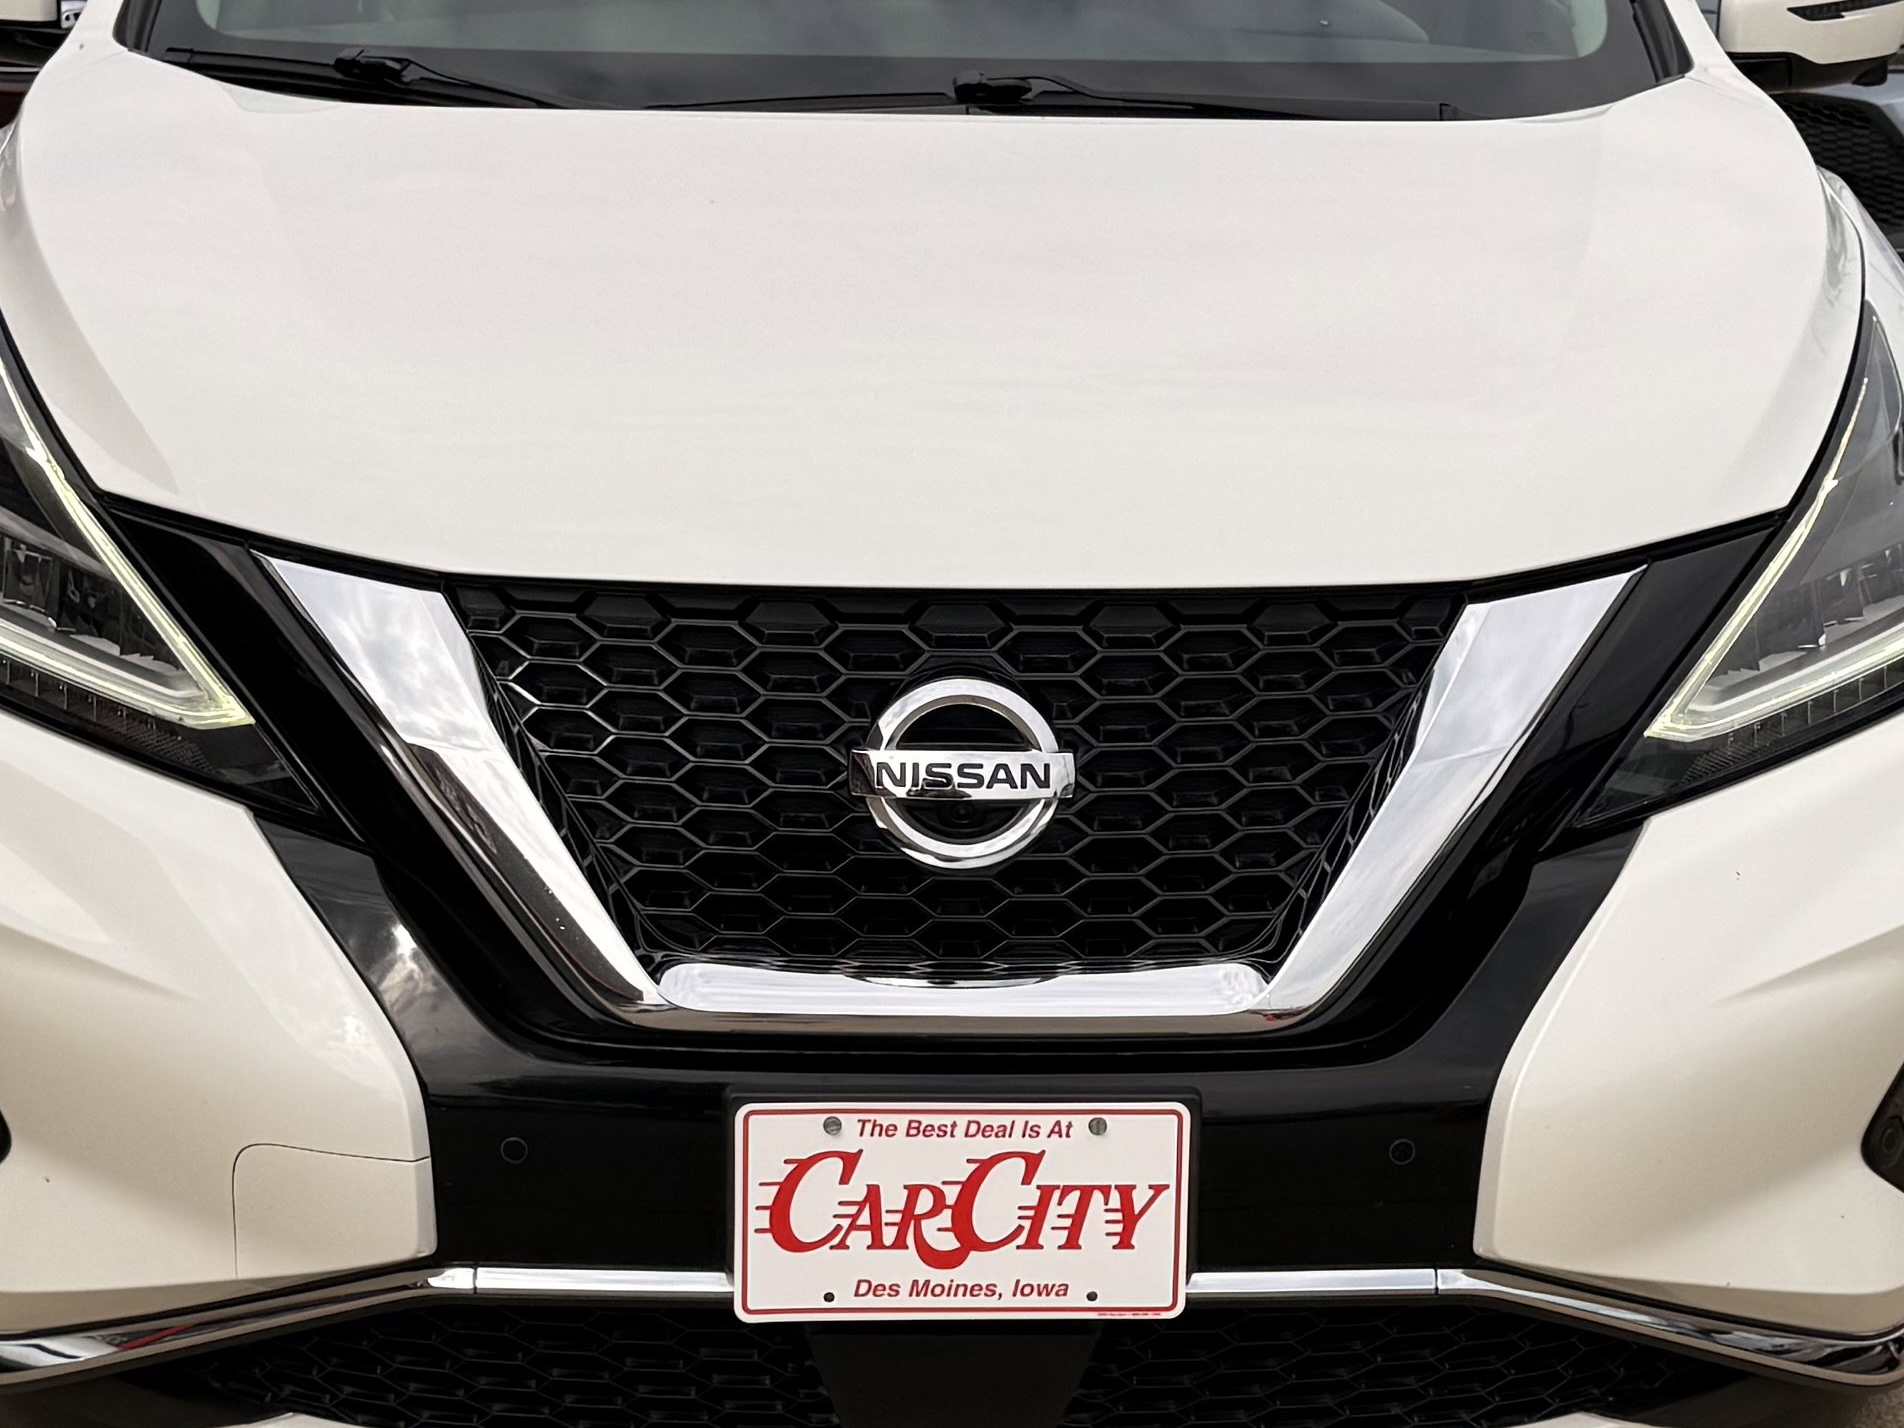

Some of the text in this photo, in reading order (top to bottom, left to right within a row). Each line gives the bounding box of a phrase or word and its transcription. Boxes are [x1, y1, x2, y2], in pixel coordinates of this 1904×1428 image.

[876, 761, 1051, 790] NISSAN
[857, 1119, 1073, 1139] The Best Deal Is At
[854, 1279, 1070, 1300] Des Moines, Iowa
